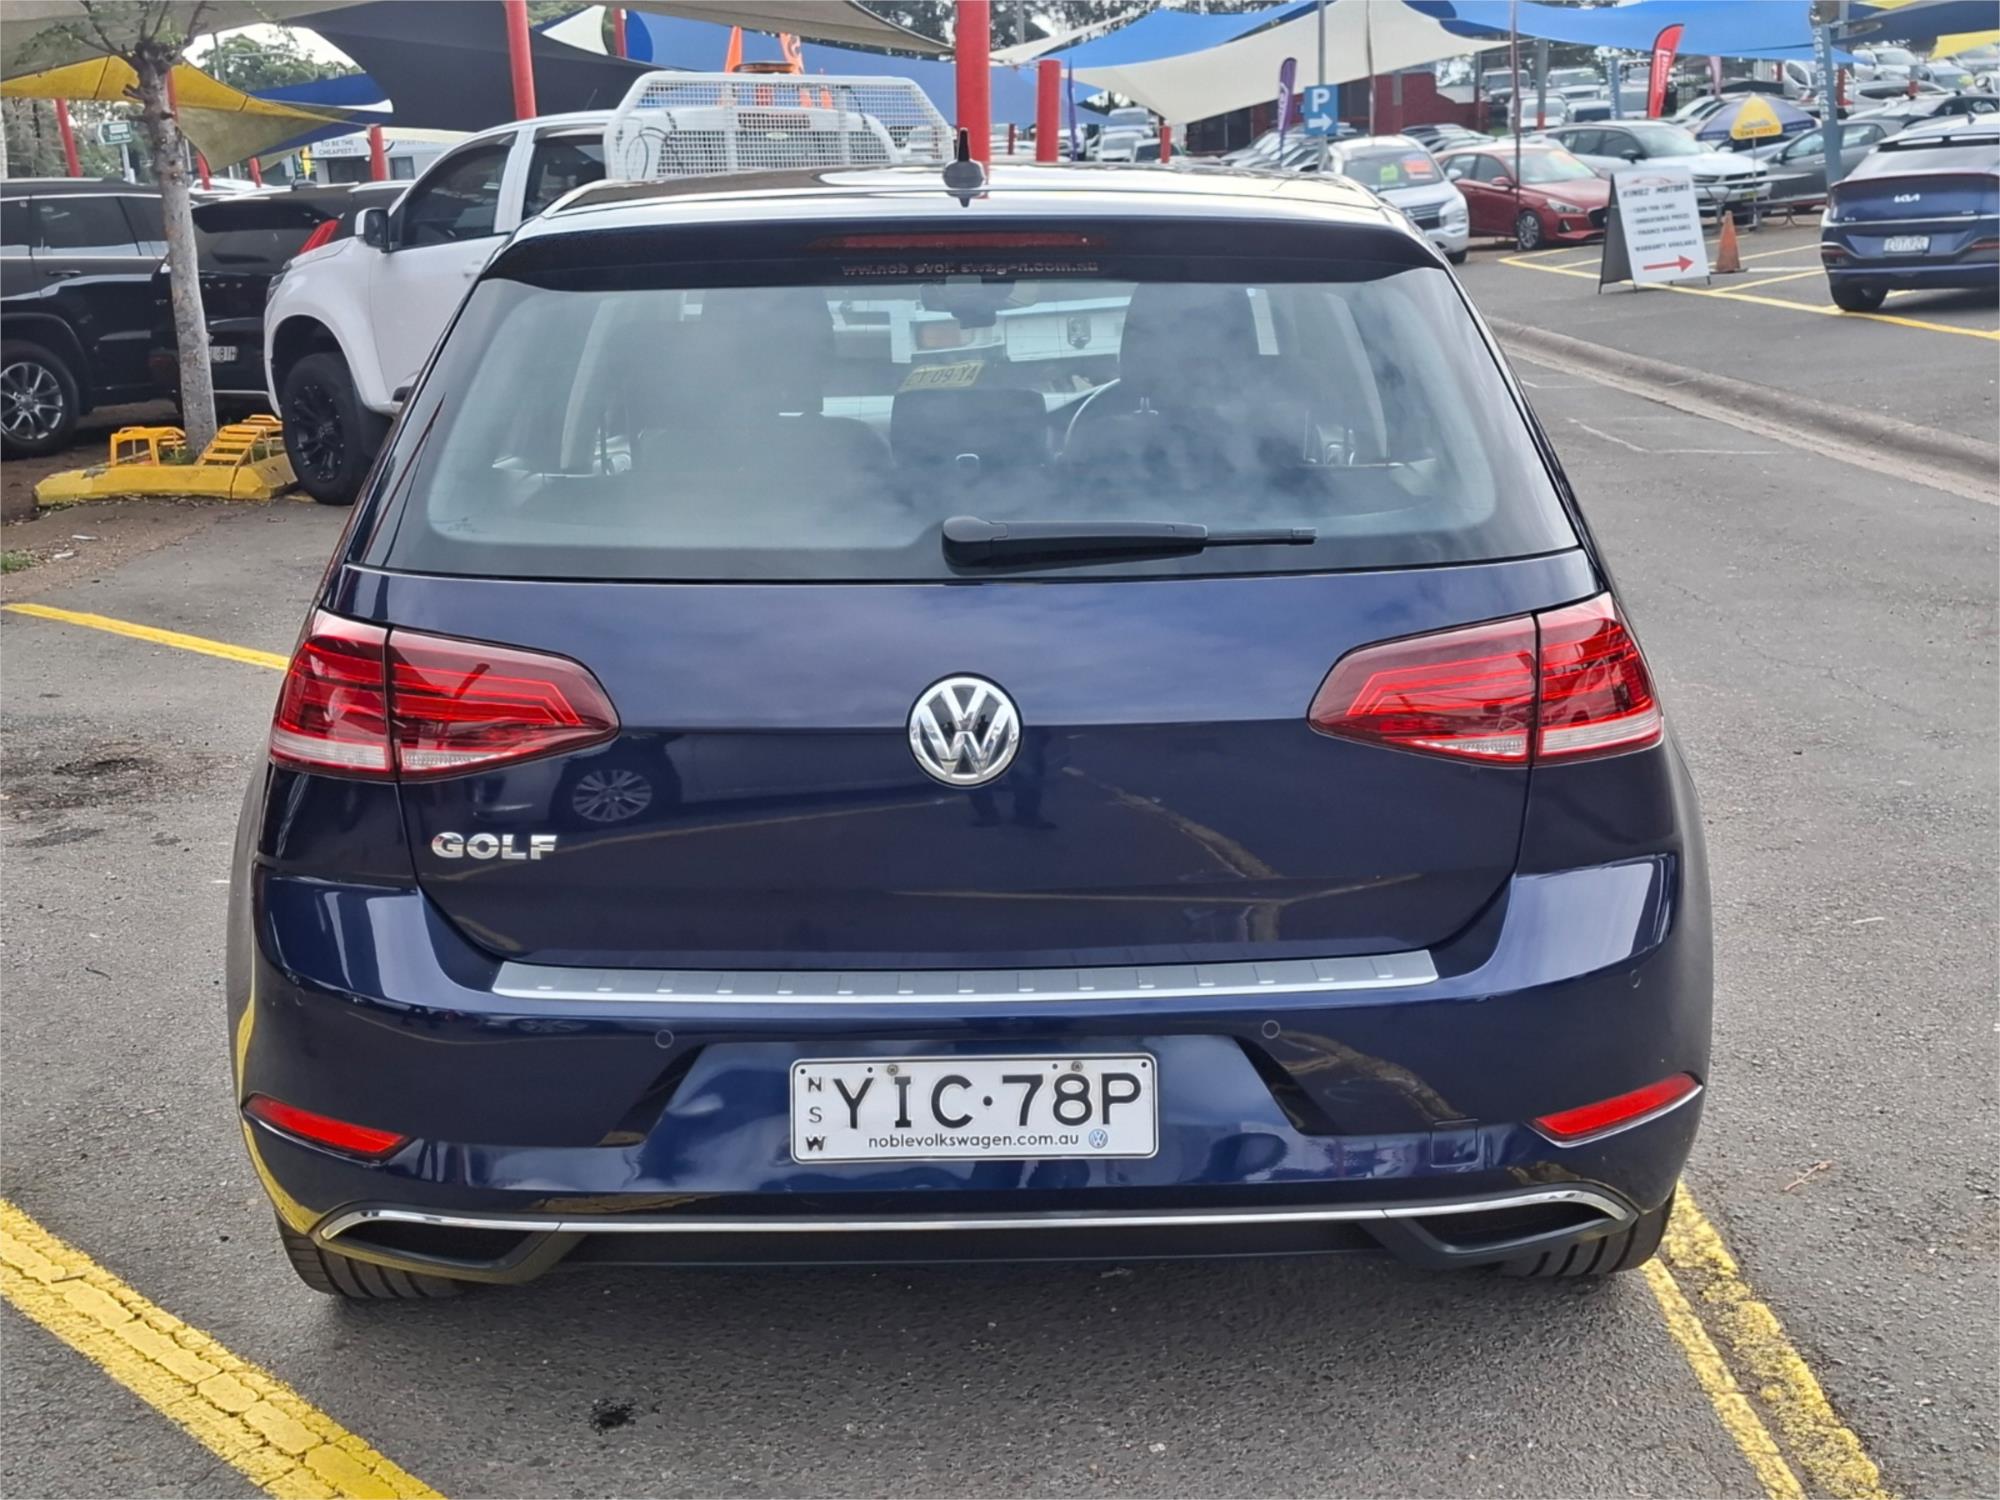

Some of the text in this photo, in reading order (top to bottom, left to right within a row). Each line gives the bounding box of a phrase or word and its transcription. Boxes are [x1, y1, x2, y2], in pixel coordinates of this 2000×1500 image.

[1311, 88, 1330, 113] P
[431, 831, 558, 861] GOLF
[868, 1132, 1080, 1150] noblevolkswagen.com.au
